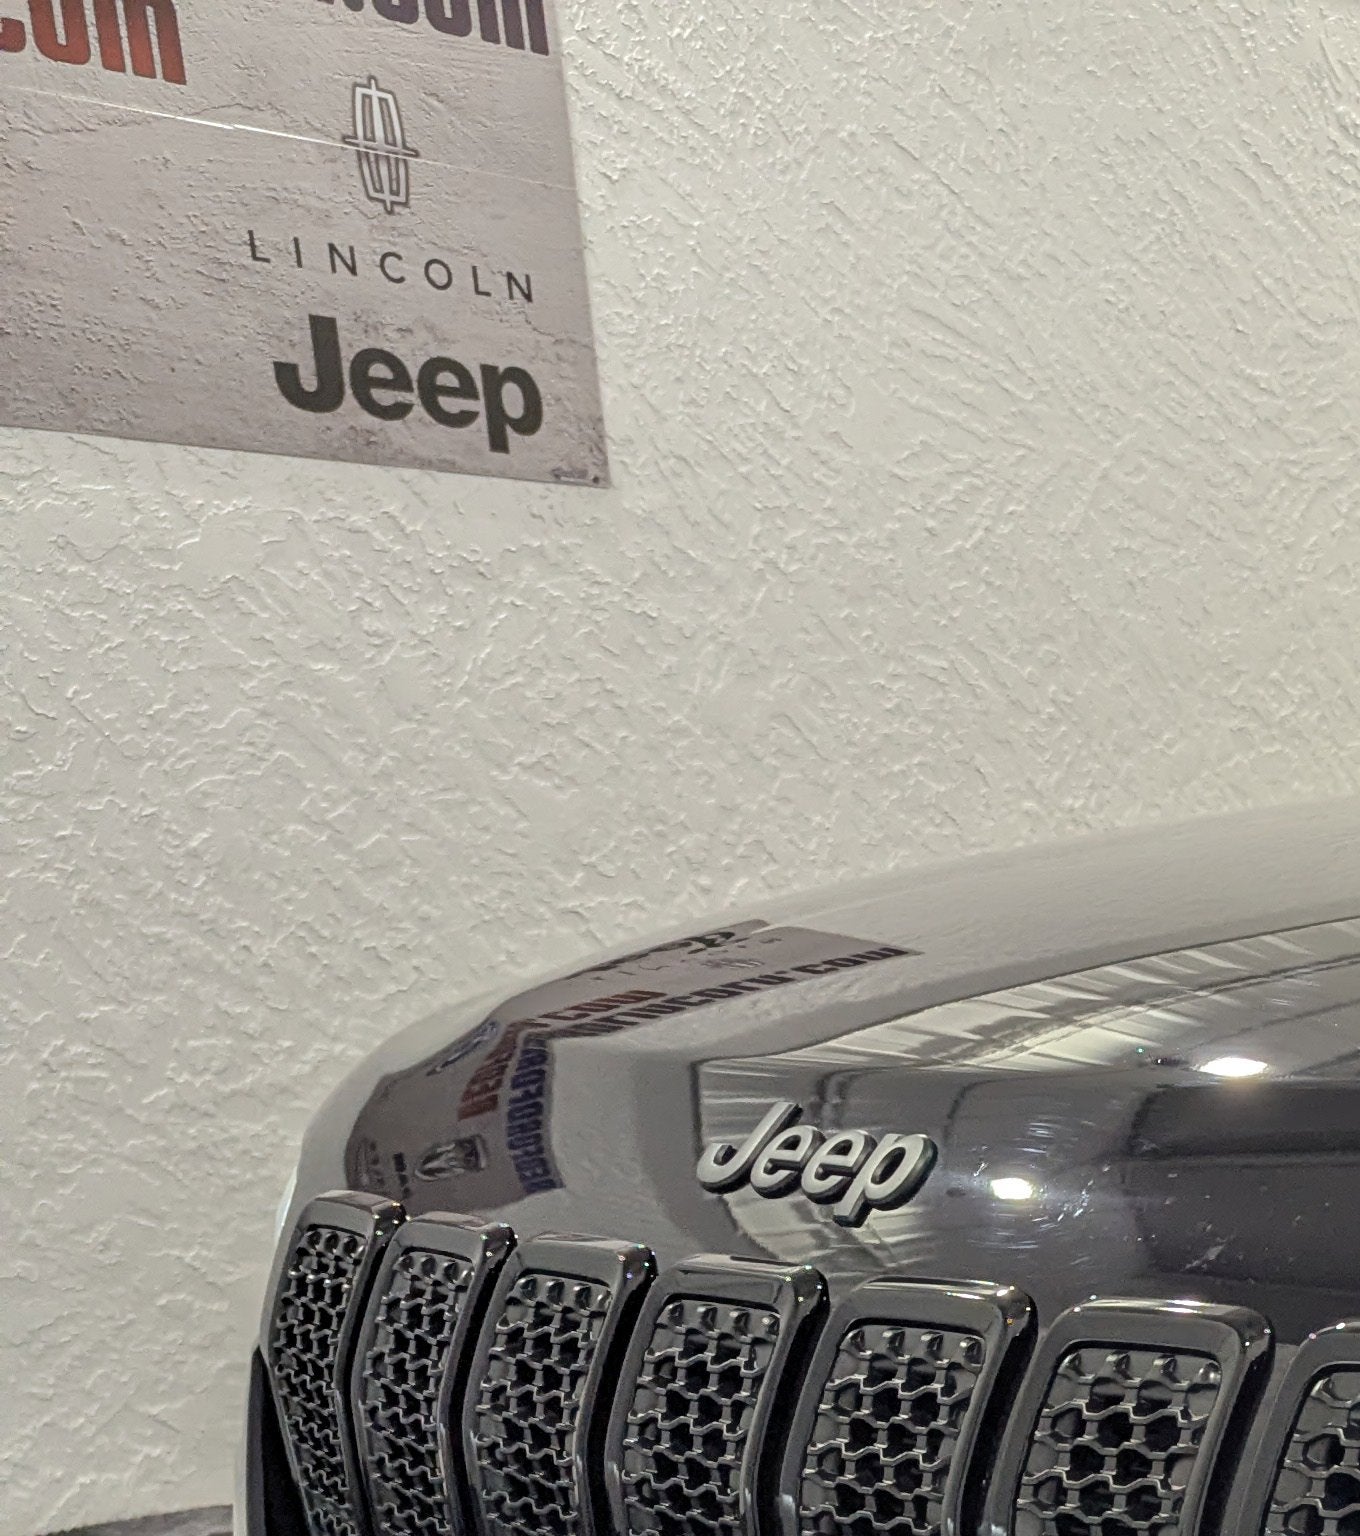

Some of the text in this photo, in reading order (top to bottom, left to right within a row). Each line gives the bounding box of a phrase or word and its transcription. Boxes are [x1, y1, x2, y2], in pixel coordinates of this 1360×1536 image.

[247, 229, 534, 303] LINCOLN
[273, 313, 544, 455] Jeep
[696, 1100, 938, 1229] Jeep
